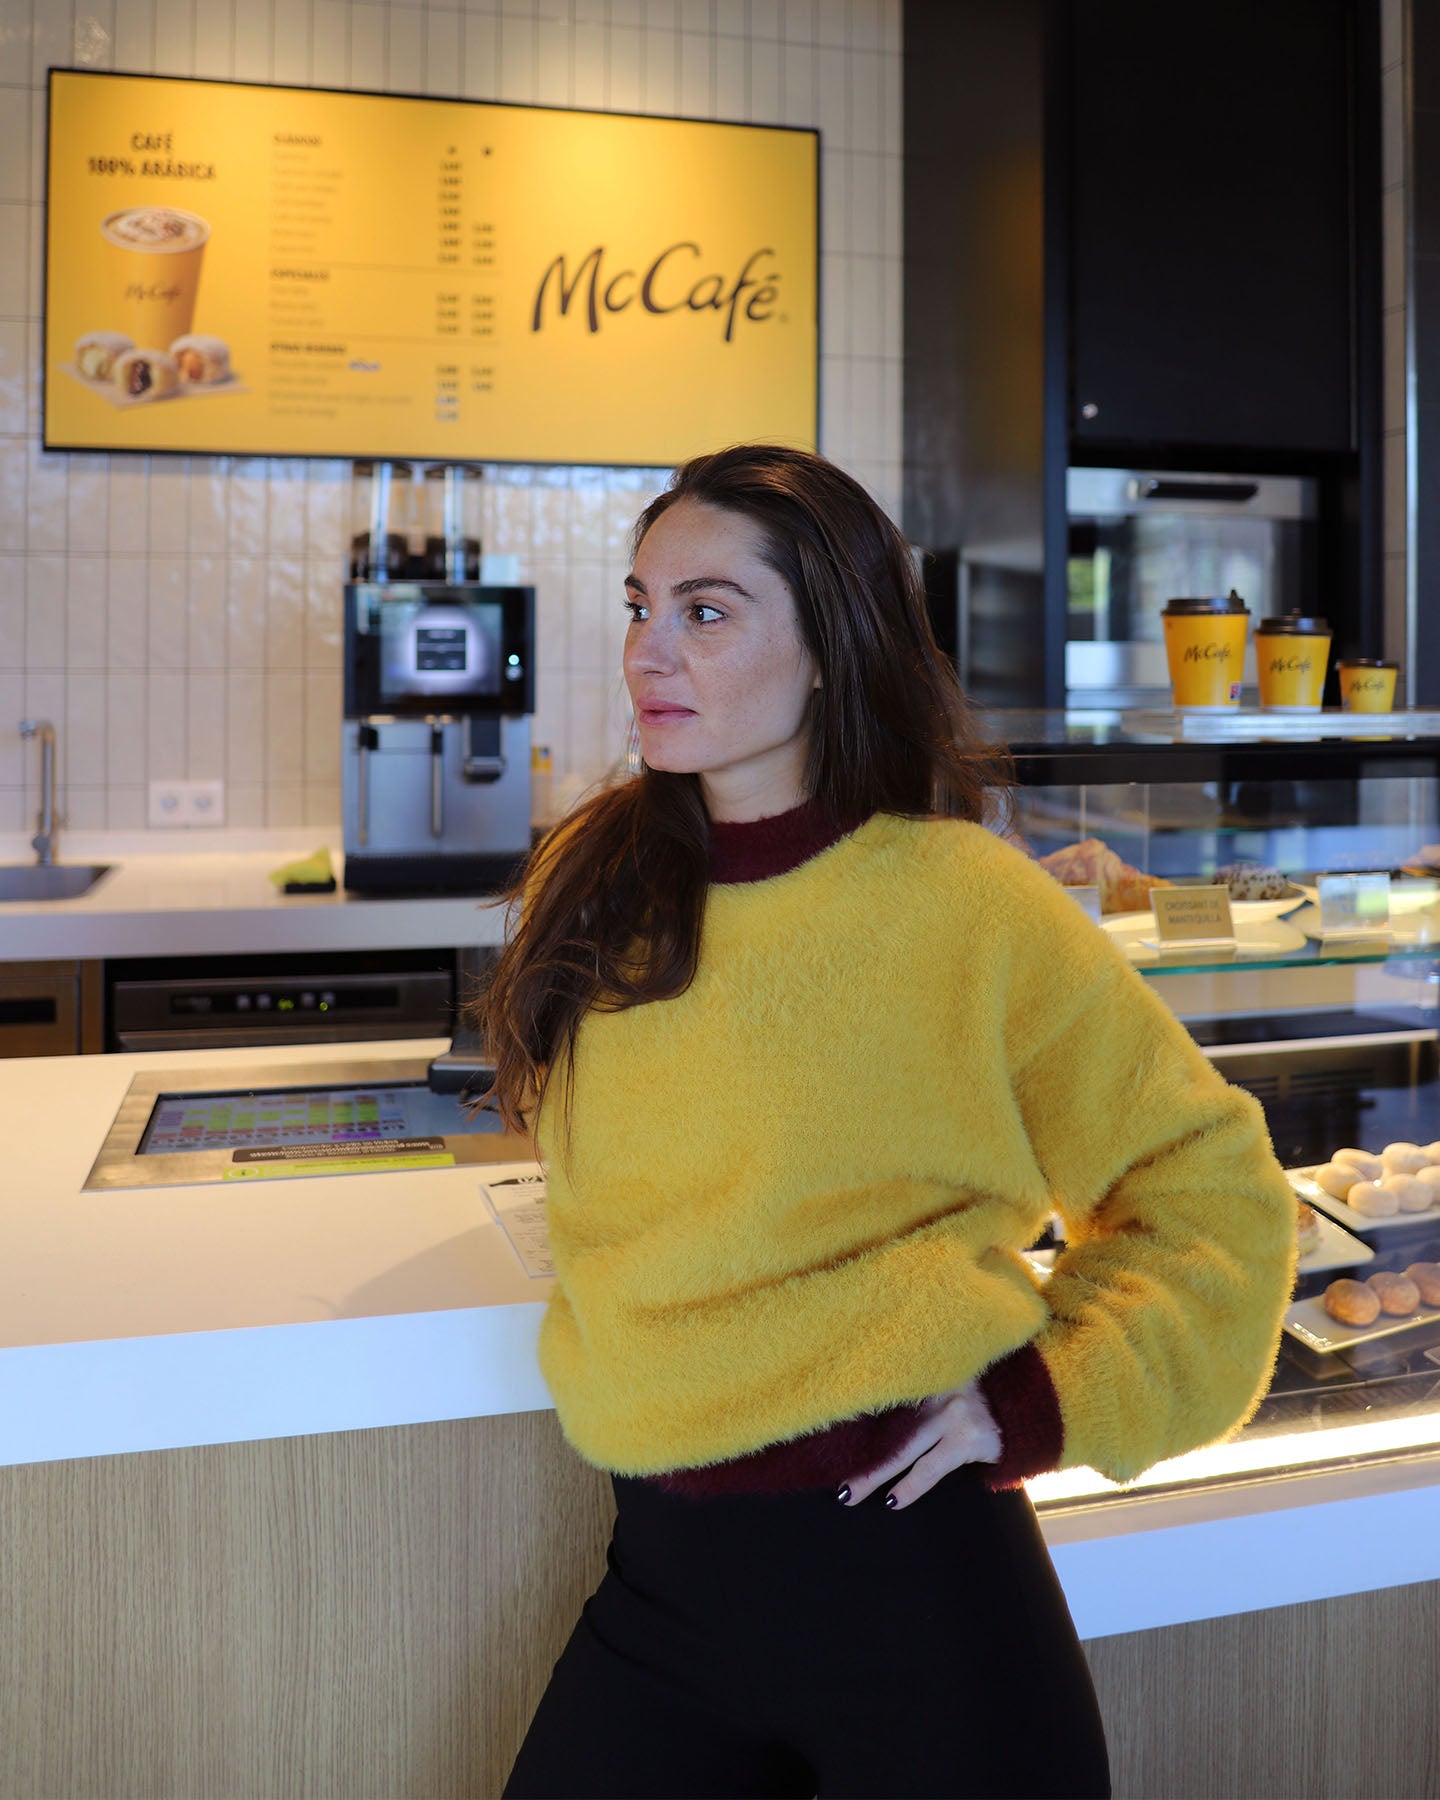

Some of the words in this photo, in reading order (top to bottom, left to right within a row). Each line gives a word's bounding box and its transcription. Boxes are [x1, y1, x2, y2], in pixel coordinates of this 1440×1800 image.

[131, 131, 174, 151] CAFÉ
[88, 157, 136, 176] 100%
[141, 156, 217, 180] ARÁBICA
[531, 241, 781, 343] McCafé
